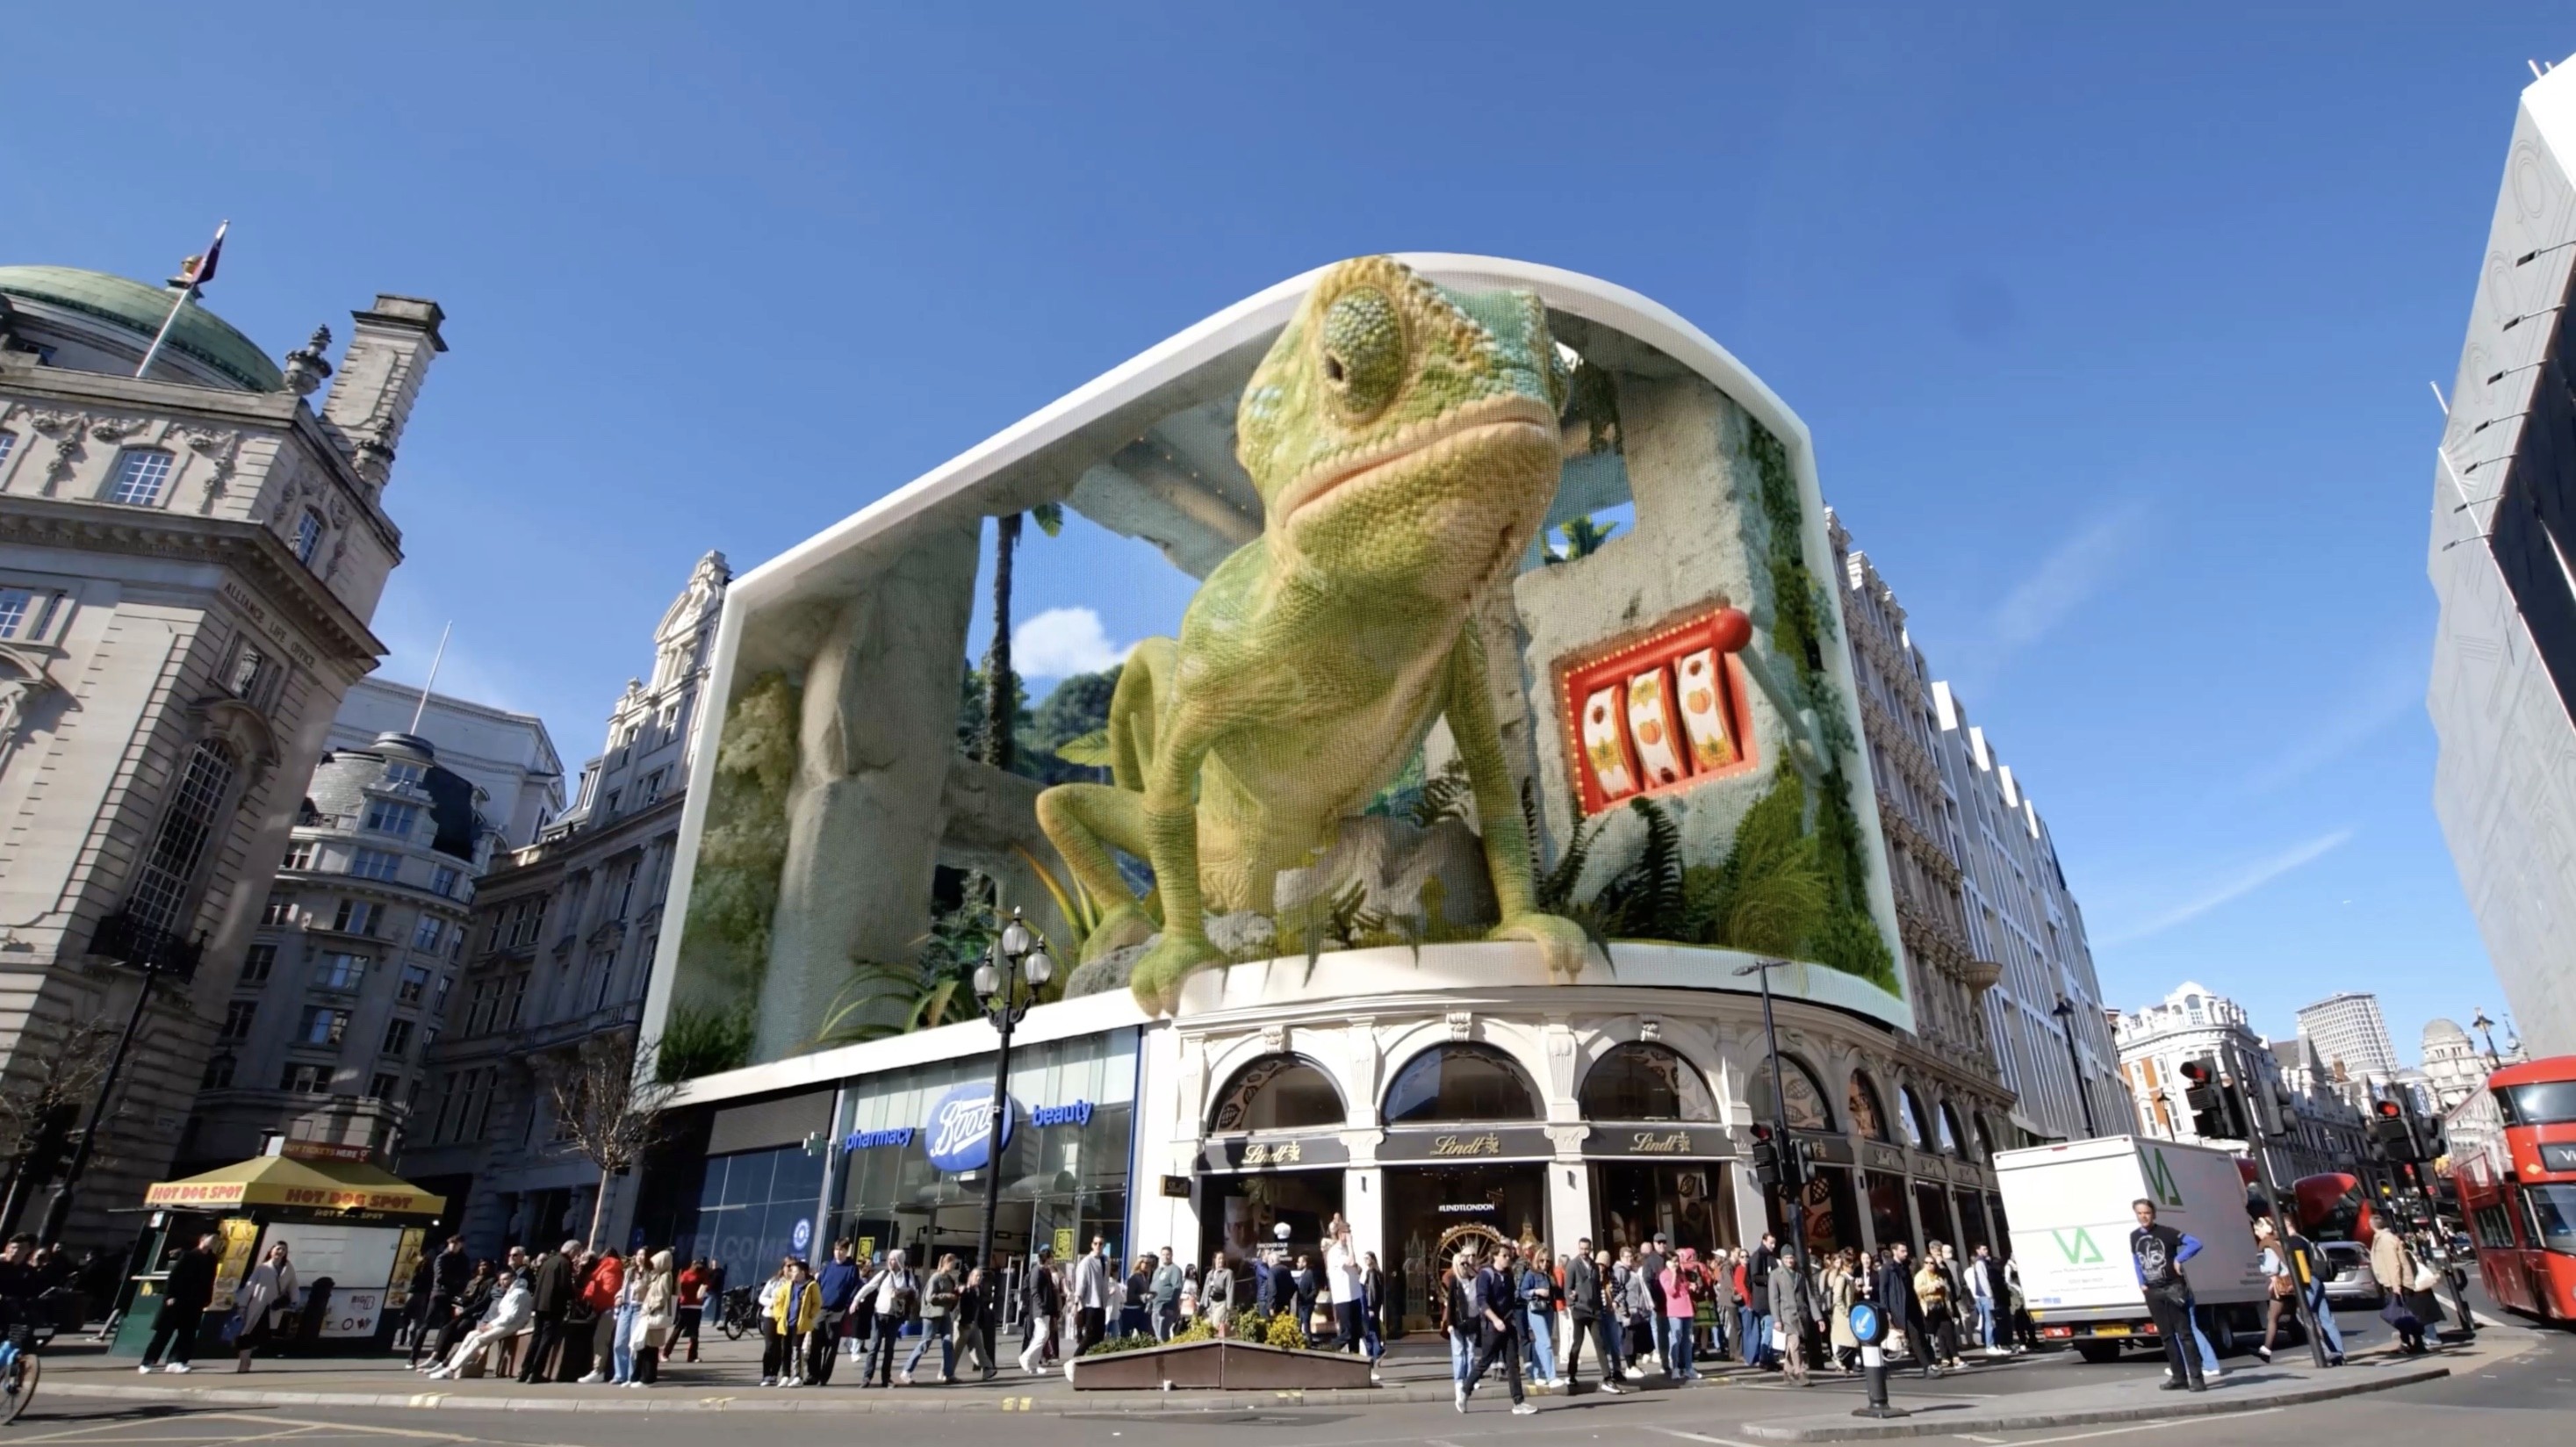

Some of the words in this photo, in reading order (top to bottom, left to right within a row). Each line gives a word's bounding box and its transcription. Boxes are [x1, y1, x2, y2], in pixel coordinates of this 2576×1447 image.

[224, 582, 264, 623] ALLIANCE
[269, 622, 287, 644] LIFE
[291, 641, 315, 668] OFFICE
[1031, 1099, 1094, 1127] beauty
[930, 1096, 995, 1158] Boot
[844, 1127, 916, 1154] pharmacy
[1429, 1135, 1487, 1156] Lindt
[1630, 1133, 1678, 1152] Lindt
[283, 1144, 300, 1154] BUY
[301, 1145, 335, 1156] TICKETS
[335, 1148, 357, 1159] HERE
[1241, 1144, 1288, 1164] Lindt
[152, 1186, 180, 1199] HOT
[181, 1186, 208, 1199] DOG
[210, 1185, 243, 1199] SPOT
[284, 1188, 325, 1204] HOT
[328, 1191, 367, 1206] DOG
[369, 1194, 414, 1209] SPOT
[1438, 1203, 1495, 1212] #LINDTLONDON
